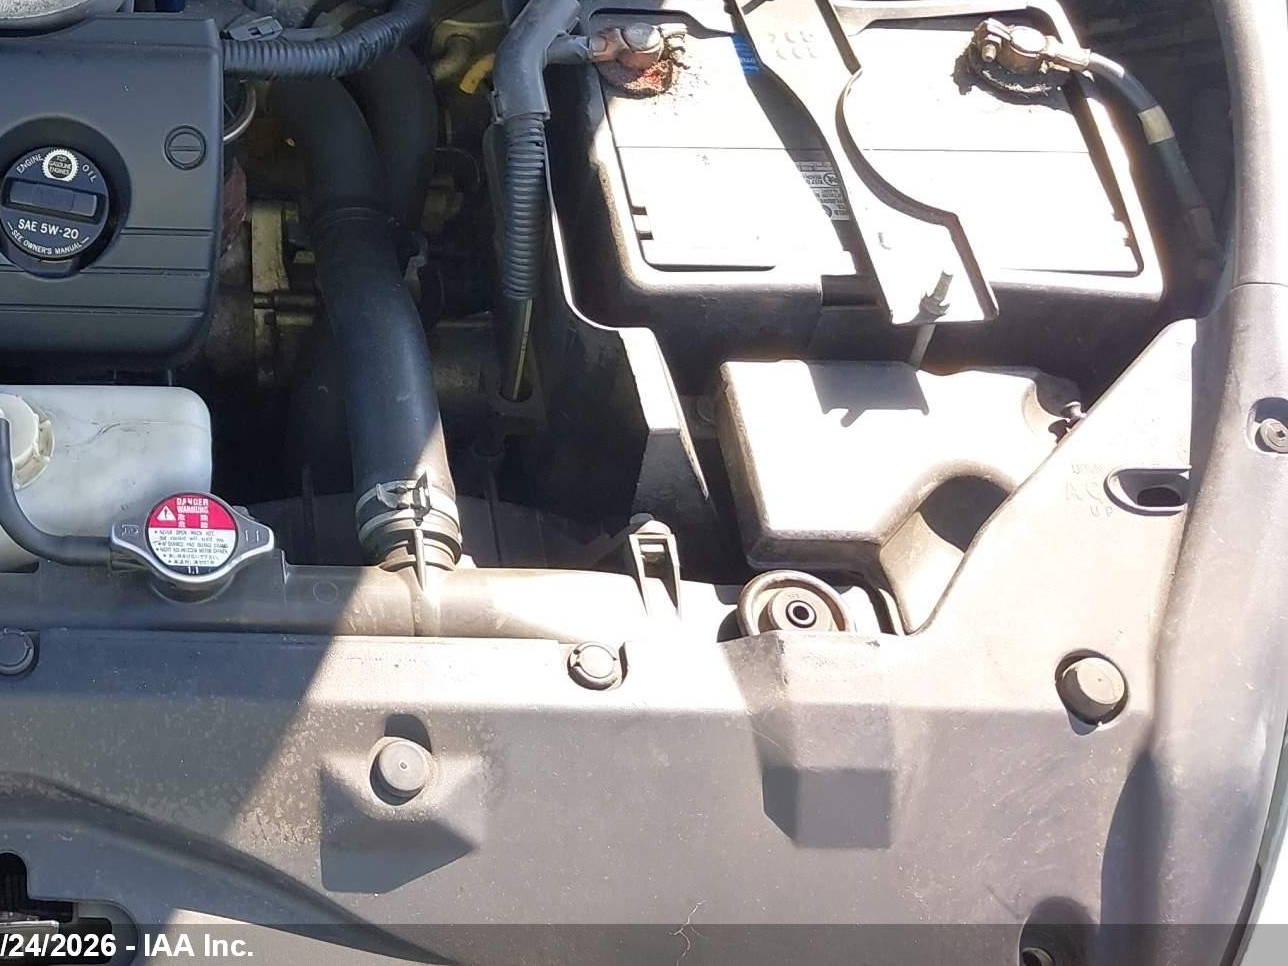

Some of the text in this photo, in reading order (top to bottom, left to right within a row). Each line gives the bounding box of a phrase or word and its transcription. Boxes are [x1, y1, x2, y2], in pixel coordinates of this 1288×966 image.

[16, 153, 98, 183] ENGINE OIL
[18, 218, 79, 240] SAE 5W-20
[11, 229, 83, 255] SEE OWNER'S MANUAL
[176, 497, 209, 506] DANGER
